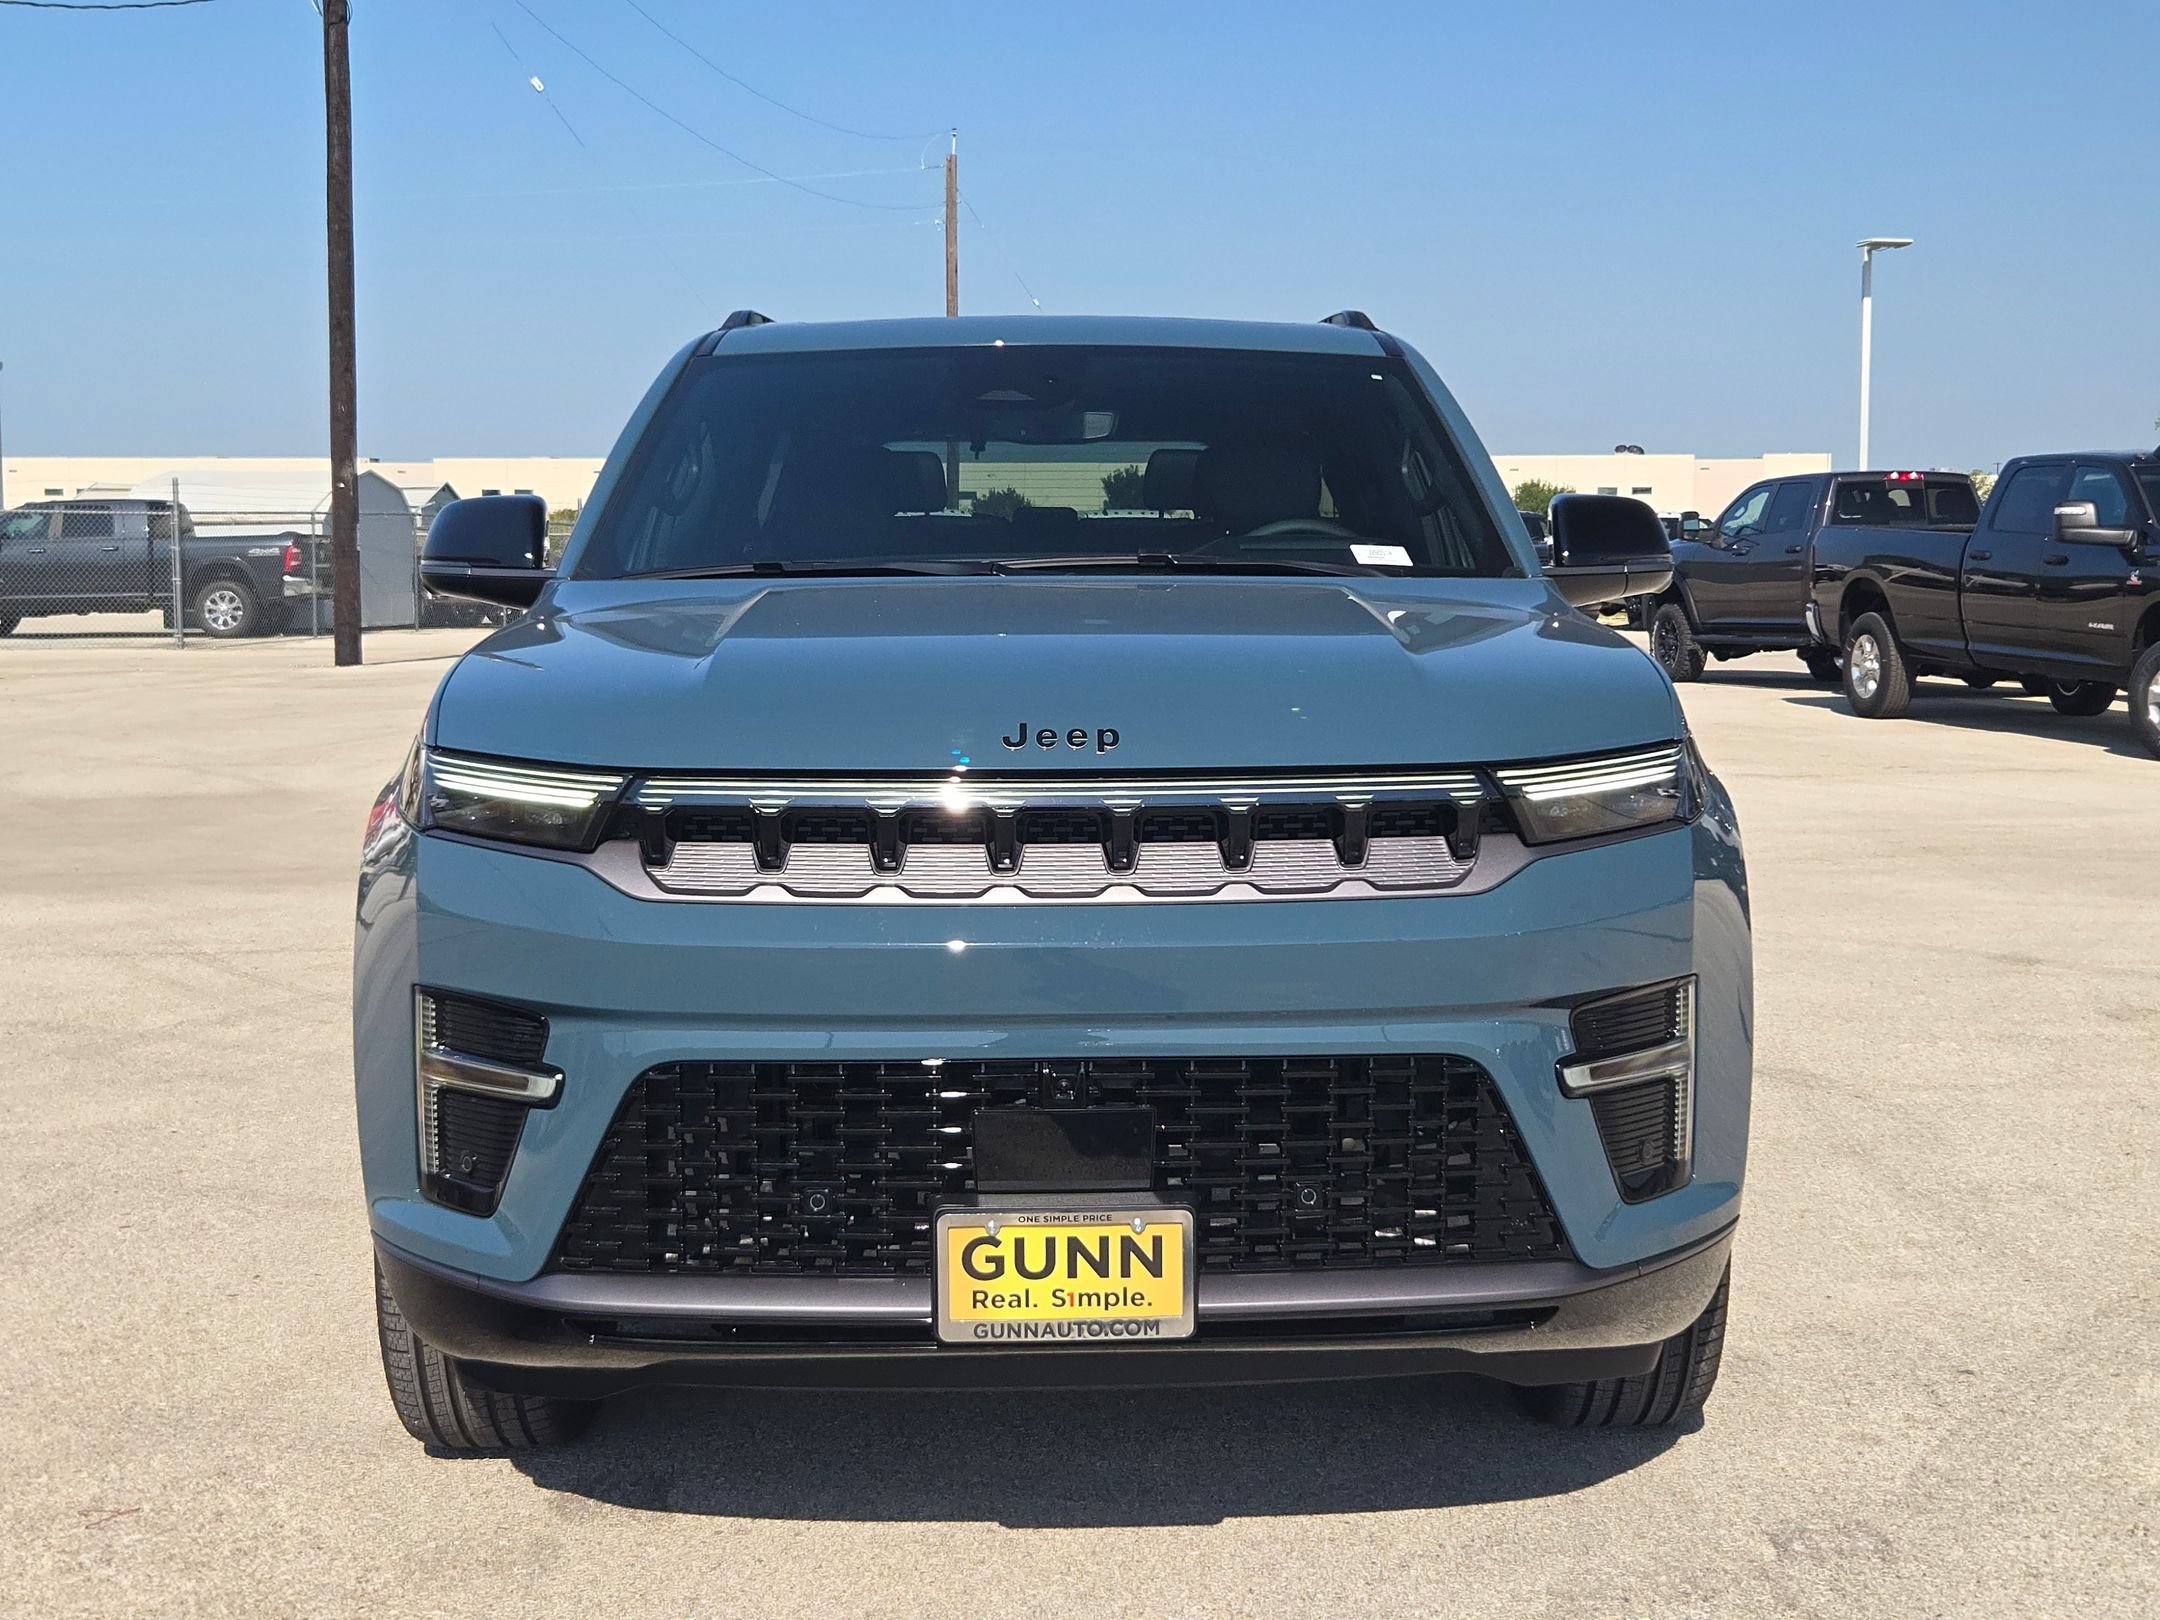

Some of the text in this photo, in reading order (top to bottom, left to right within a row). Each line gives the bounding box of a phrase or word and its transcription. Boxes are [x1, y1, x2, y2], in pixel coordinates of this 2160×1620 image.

[1002, 722, 1120, 754] Jeep
[1043, 1215, 1079, 1223] SIMPLE
[1083, 1214, 1113, 1222] PRICE
[961, 1235, 1163, 1280] GUNN
[972, 1288, 1038, 1309] Real.
[973, 1320, 1160, 1339] GUNNAUTO.COM
